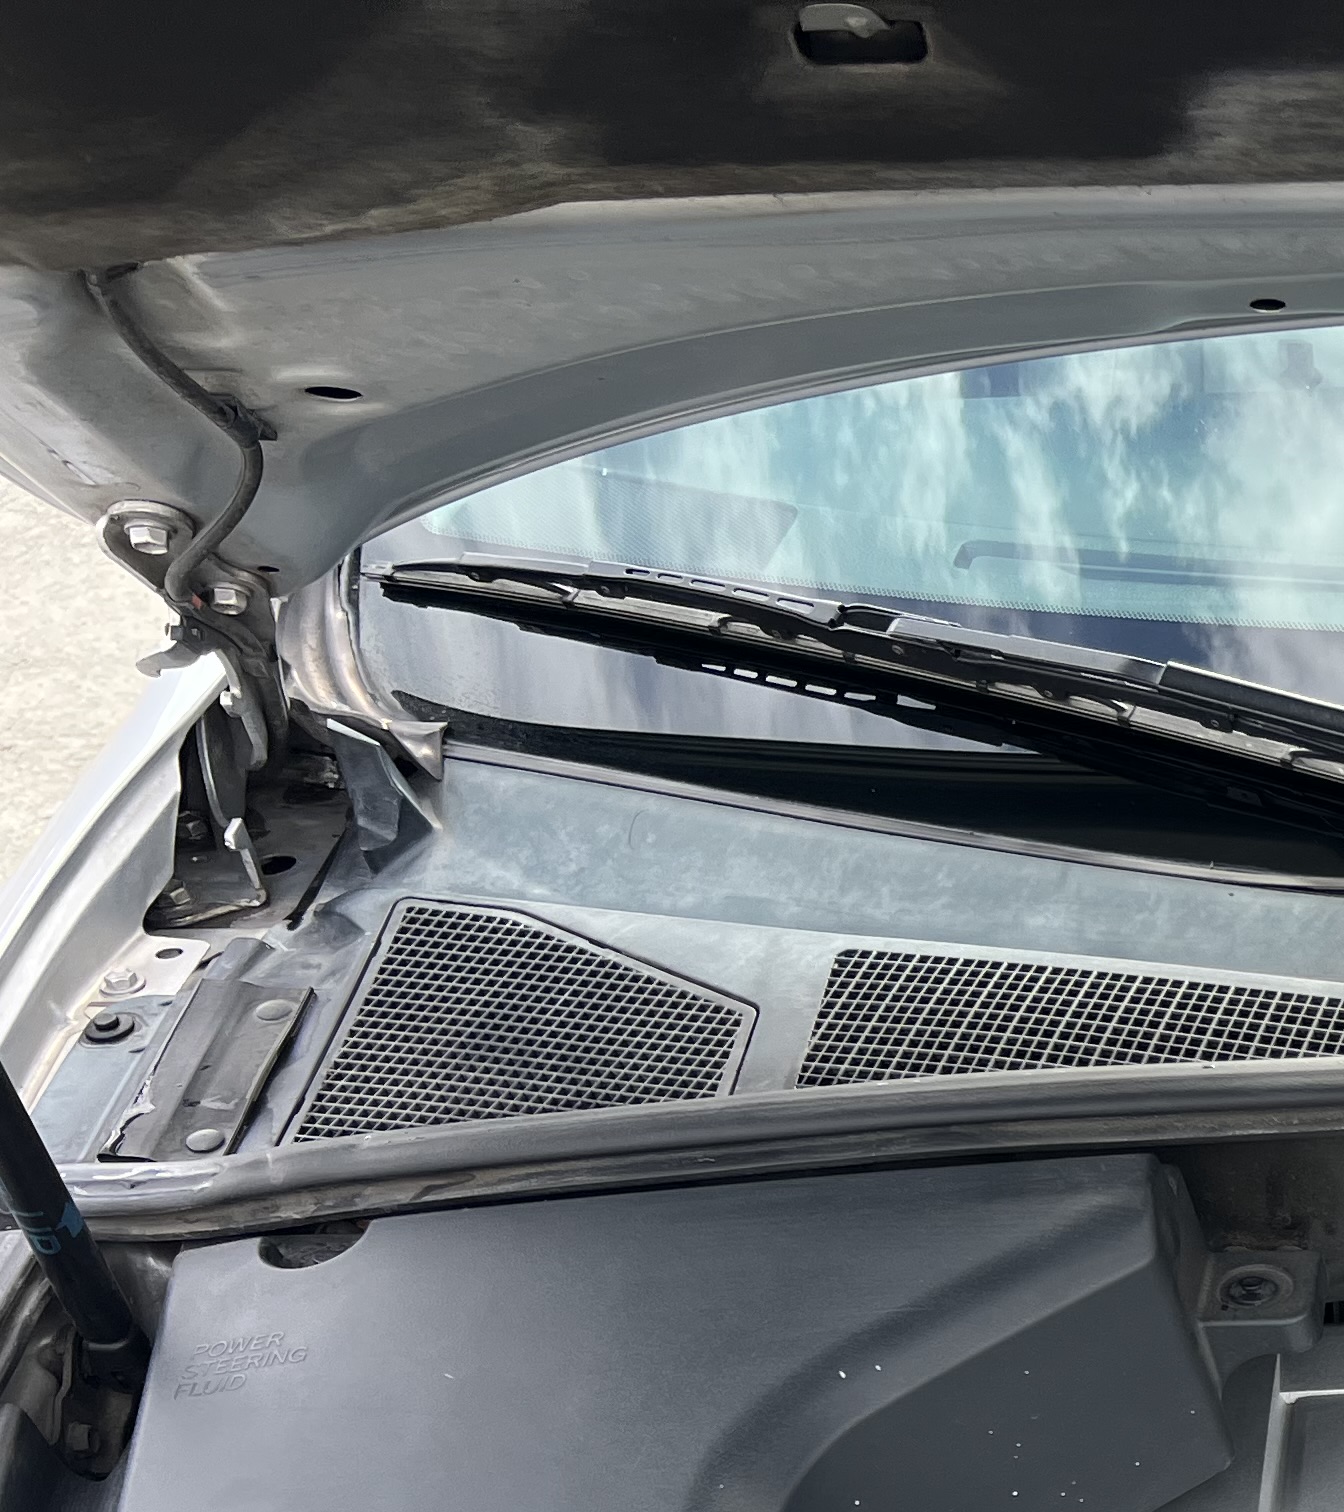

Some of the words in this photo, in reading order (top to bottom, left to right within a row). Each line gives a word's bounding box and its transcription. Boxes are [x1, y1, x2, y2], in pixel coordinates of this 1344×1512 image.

[193, 1331, 285, 1358] POWER
[181, 1346, 308, 1380] STEERING
[173, 1373, 247, 1400] FLUID
